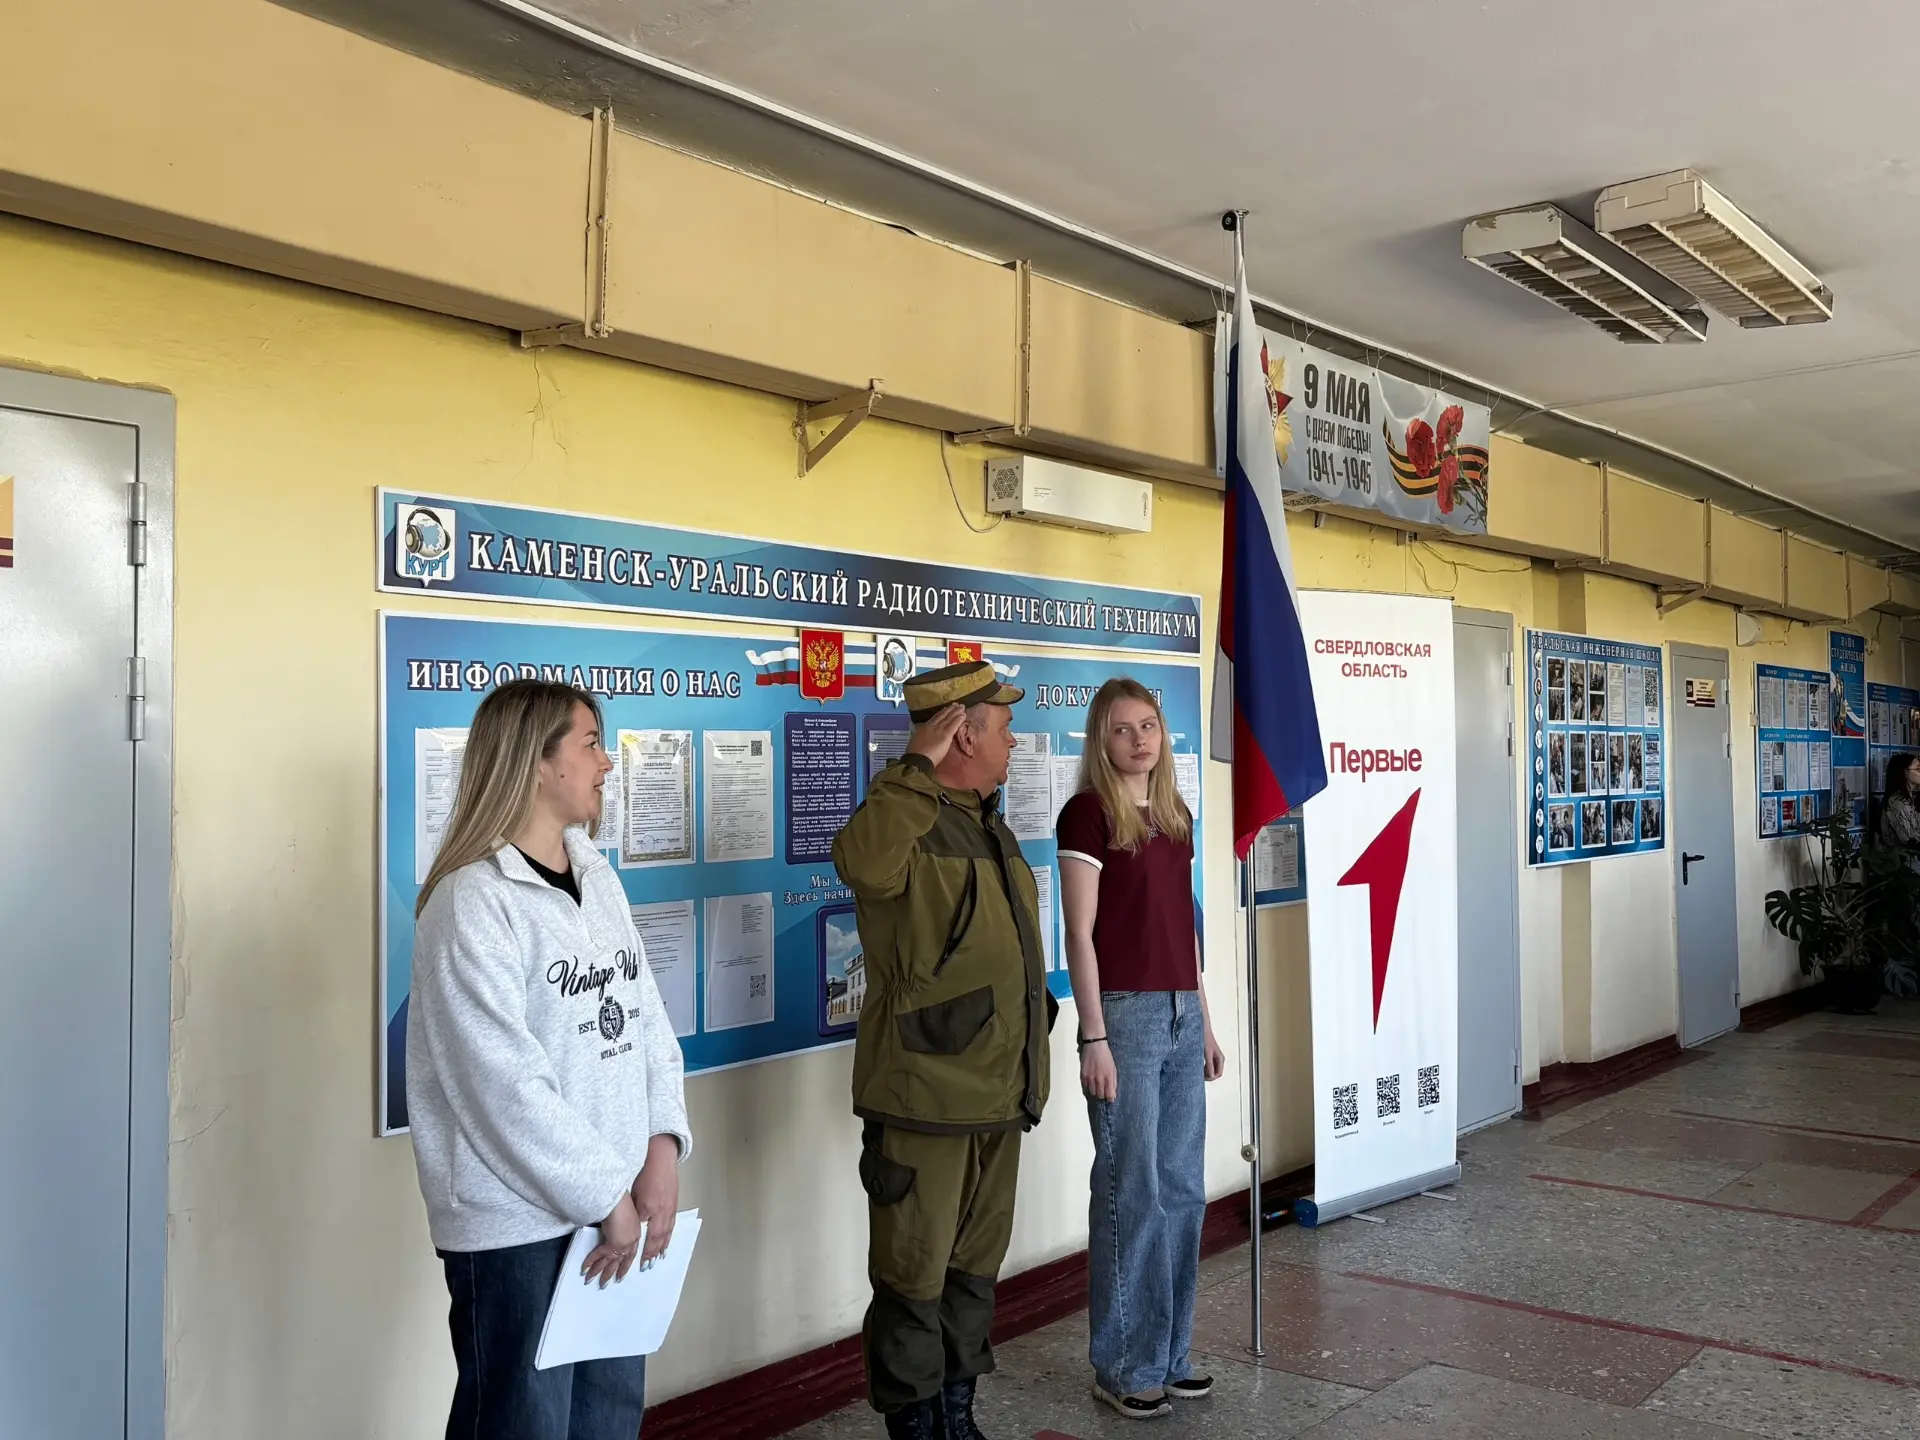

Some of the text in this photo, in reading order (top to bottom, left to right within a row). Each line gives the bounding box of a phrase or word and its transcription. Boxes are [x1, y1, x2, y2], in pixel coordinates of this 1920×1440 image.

[1304, 363, 1320, 409] 9
[1325, 369, 1371, 425] МАЯ
[1306, 414, 1372, 454] С ДНЕМ ПОБЕДЫ!
[1306, 447, 1372, 495] 1941-1945
[405, 553, 450, 579] КУРТ
[469, 531, 1198, 639] КАМЕНСК-УРАЛЬСКИЙ РАДИОТЕХНИЧЕСКИЙ ТЕХНИКУМ
[1314, 639, 1432, 658] СВЕРДЛОВСКАЯ
[1532, 635, 1581, 653] УРАЛЬСКАЯ
[1583, 642, 1634, 659] ИНЖЕНЕРНАЯ
[662, 670, 680, 696] О
[687, 670, 741, 698] НАС
[1341, 662, 1408, 679] ОБЛАСТЬ
[1329, 742, 1423, 783] Первые
[810, 875, 830, 888] Мы
[784, 889, 855, 906] Здесь начи
[546, 955, 616, 1002] Vintage
[578, 1020, 597, 1035] EST.
